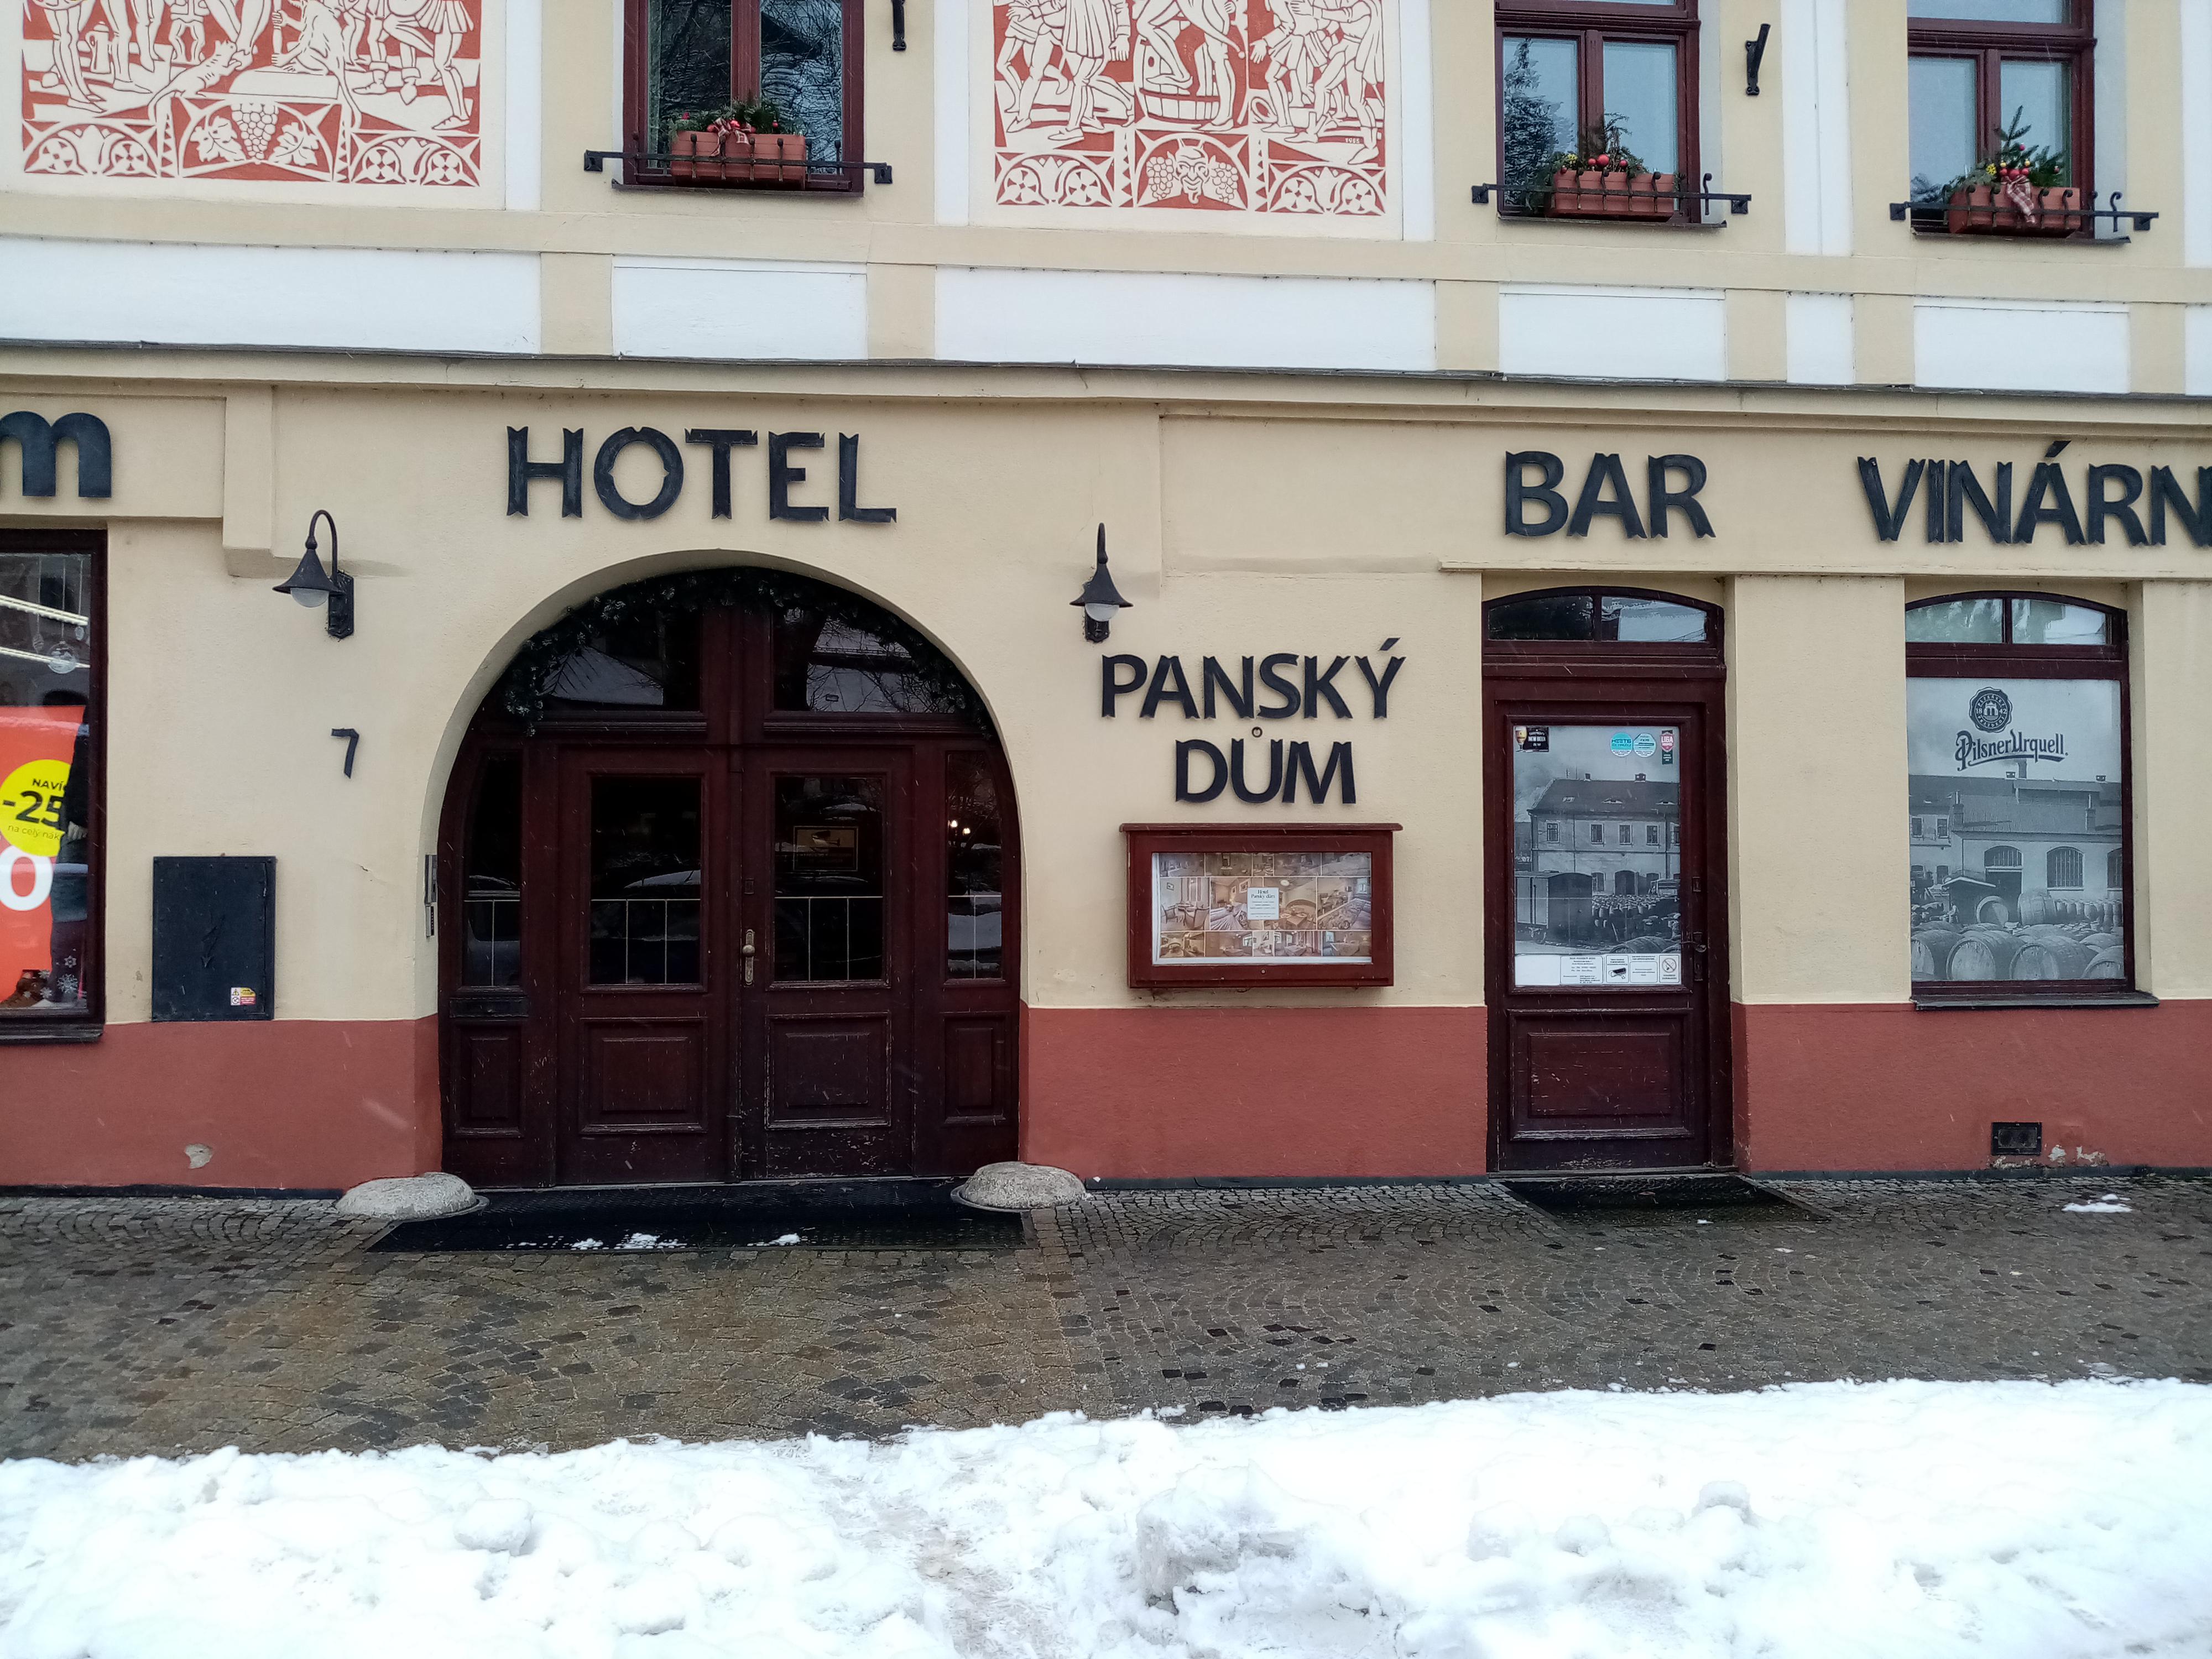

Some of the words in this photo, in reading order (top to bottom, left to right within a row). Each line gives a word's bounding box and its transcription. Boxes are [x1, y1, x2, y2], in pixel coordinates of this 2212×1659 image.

[506, 425, 897, 523] HOTEL
[1505, 450, 1716, 539] BAR
[1857, 440, 2212, 547] VINÁRN
[1102, 638, 1407, 719] PANSKÝ
[331, 728, 359, 779] 7
[1175, 727, 1357, 804] DŮM
[1955, 730, 2012, 771] Pilsner
[2010, 728, 2064, 763] Urquell
[22, 827, 41, 837] celý
